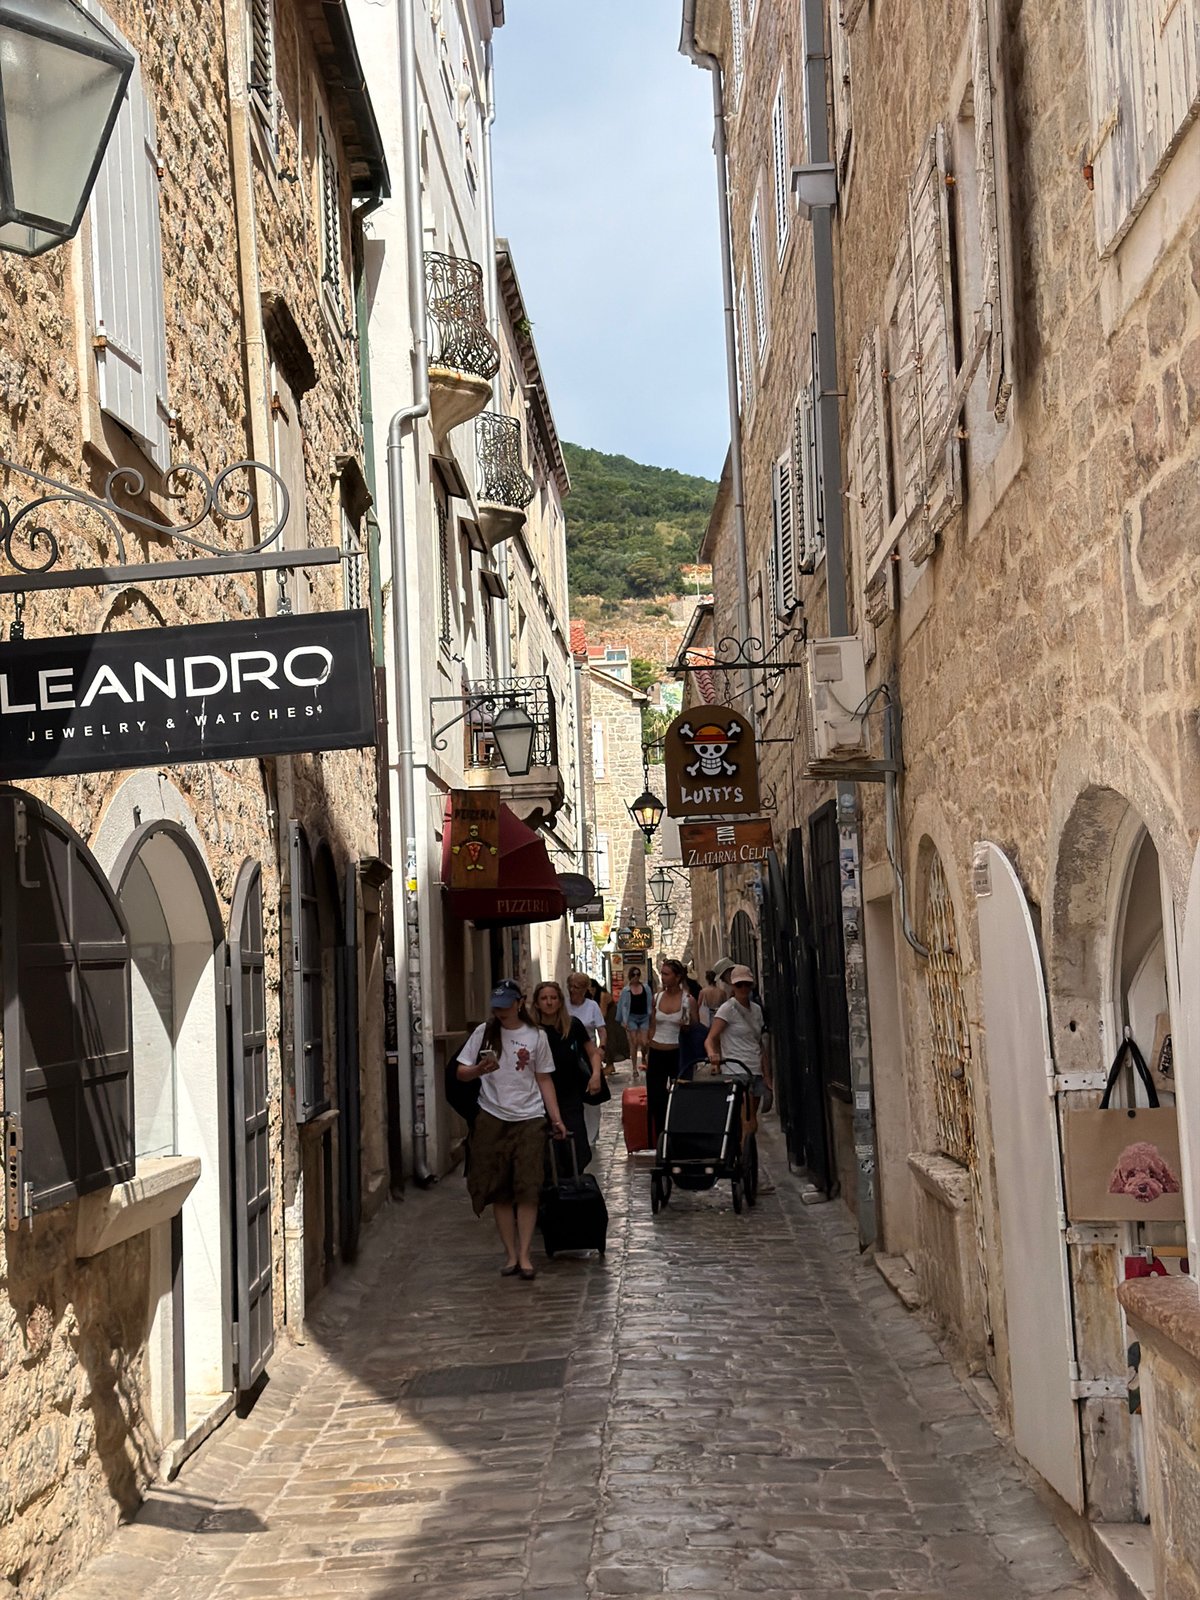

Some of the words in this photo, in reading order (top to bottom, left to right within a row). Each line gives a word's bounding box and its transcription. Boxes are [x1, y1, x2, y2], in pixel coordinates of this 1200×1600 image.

[0, 645, 333, 714] LEANDRO
[28, 720, 147, 742] JEWELRY
[165, 718, 175, 729] &
[195, 705, 314, 727] WATCHES
[681, 786, 744, 804] LUFFYS
